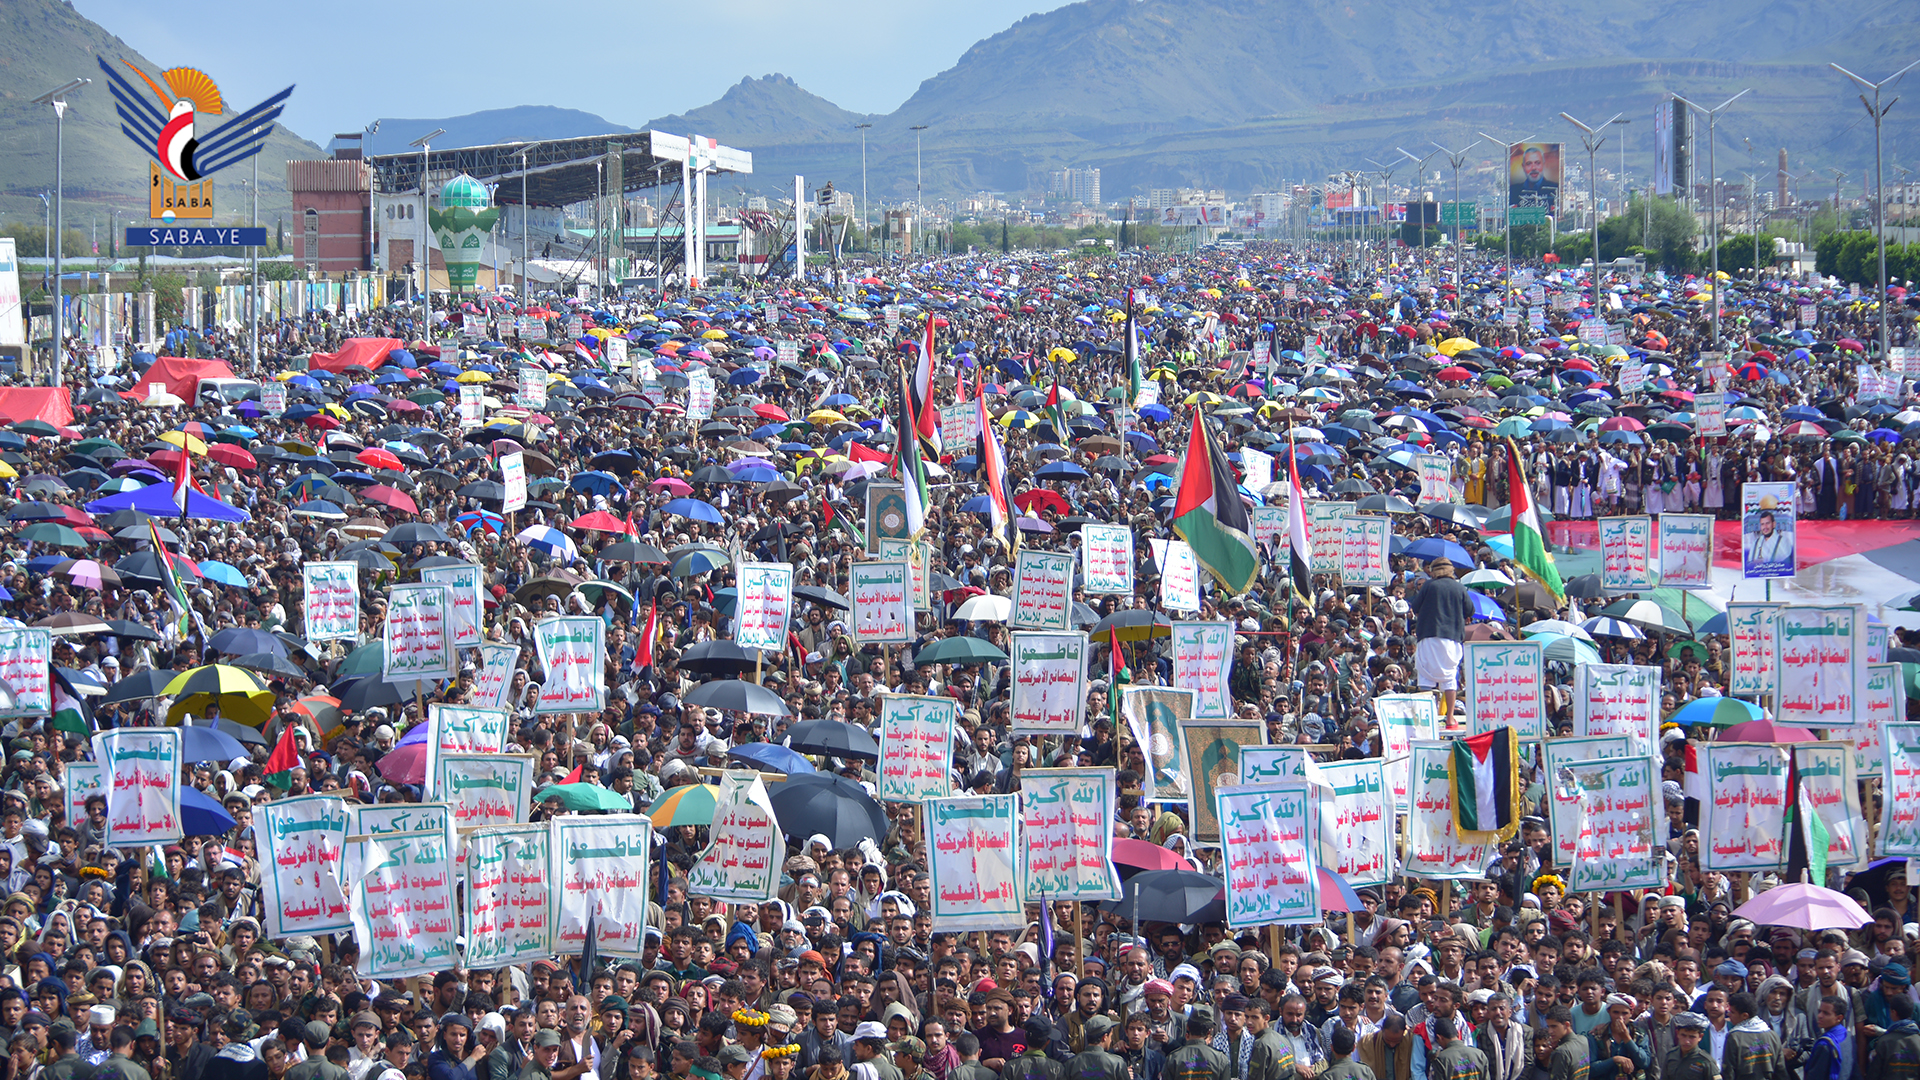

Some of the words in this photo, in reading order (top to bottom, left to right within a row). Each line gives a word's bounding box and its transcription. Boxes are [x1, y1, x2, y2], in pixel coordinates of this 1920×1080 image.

[856, 570, 902, 588] قاطعوا
[856, 589, 880, 606] الأمريكية
[881, 591, 903, 605] البضائع
[878, 607, 882, 619] و
[857, 622, 904, 637] الإسرائيلية
[1781, 616, 1849, 641] قاطعوا
[1018, 643, 1079, 665] قاطعوا
[1476, 648, 1512, 671] أكبر
[1514, 650, 1536, 666] الله
[1782, 644, 1818, 668] الأمريكية
[1819, 646, 1850, 667] البضائع
[1018, 667, 1048, 687] الأمريكية
[1049, 669, 1077, 686] البضائع
[1476, 671, 1508, 686] لأمريكا
[1511, 673, 1536, 686] الموت
[1813, 671, 1818, 688] و
[1042, 690, 1046, 702] و
[1477, 690, 1508, 704] لإسرائيل
[1511, 690, 1537, 703] الموت
[1782, 694, 1850, 715] الإسرائيلية
[887, 701, 925, 726] أكبر
[925, 706, 949, 724] الله
[1014, 708, 1074, 724] الإسرائيلية
[1477, 708, 1499, 721] اليهود
[1502, 707, 1514, 721] على
[1517, 706, 1538, 719] اللعنة
[886, 725, 918, 742] لأمريكا
[920, 731, 948, 744] الموت
[884, 746, 918, 761] لإسرائيل
[919, 750, 947, 763] الموت
[883, 763, 908, 778] اليهود
[910, 765, 923, 779] على
[925, 765, 945, 779] اللعنة
[1712, 754, 1782, 783] قاطعوا
[449, 769, 517, 795] قاطعوا
[884, 780, 916, 799] للإسلام
[918, 780, 946, 800] النصر
[1023, 778, 1069, 810] أكبر
[1072, 782, 1101, 803] الله
[1714, 783, 1749, 809] الأمريكية
[1750, 787, 1782, 808] البضائع
[485, 799, 514, 820] البضائع
[933, 797, 1009, 825] قاطعوا
[1225, 795, 1271, 828] أكبر
[1274, 797, 1303, 818] الله
[1351, 805, 1381, 828] البضائع
[271, 807, 343, 840] قاطعوا
[1025, 807, 1066, 829] لأمريكا
[1070, 812, 1101, 827] الموت
[1743, 812, 1749, 828] و
[1227, 825, 1268, 847] لأمريكا
[1271, 826, 1304, 844] الموت
[1444, 819, 1451, 837] و
[565, 835, 641, 865] قاطعوا
[737, 836, 770, 850] الموت
[936, 827, 975, 855] الأمريكية
[976, 829, 1009, 852] البضائع
[1071, 834, 1102, 848] الموت
[1347, 833, 1351, 848] و
[277, 841, 315, 869] الأمريكية
[414, 841, 443, 864] الله
[722, 854, 738, 868] على
[743, 855, 768, 869] اللعنة
[1081, 852, 1104, 869] اللعنة
[1230, 851, 1270, 871] لإسرائيل
[1272, 848, 1306, 867] الموت
[1416, 844, 1482, 867] الإسرائيلية
[971, 856, 977, 874] و
[1061, 854, 1076, 871] على
[314, 871, 320, 888] و
[366, 871, 408, 894] لأمريكا
[411, 871, 447, 890] الموت
[565, 867, 604, 894] الأمريكية
[605, 869, 641, 893] البضائع
[731, 873, 766, 893] النصر
[1029, 874, 1071, 897] للإسلام
[1072, 872, 1108, 896] النصر
[1231, 873, 1260, 893] اليهود
[1262, 872, 1278, 890] على
[1283, 870, 1309, 885] اللعنة
[940, 881, 1013, 905] الإسرائيلية
[1275, 889, 1310, 915] النصر
[369, 897, 410, 919] لإسرائيل
[414, 894, 450, 914] الموت
[596, 899, 603, 916] و
[1232, 893, 1271, 918] للإسلام
[374, 922, 402, 941] اليهود
[405, 920, 420, 939] على
[424, 917, 452, 933] اللعنة
[375, 942, 415, 968] للإسلام
[420, 938, 455, 964] النصر
